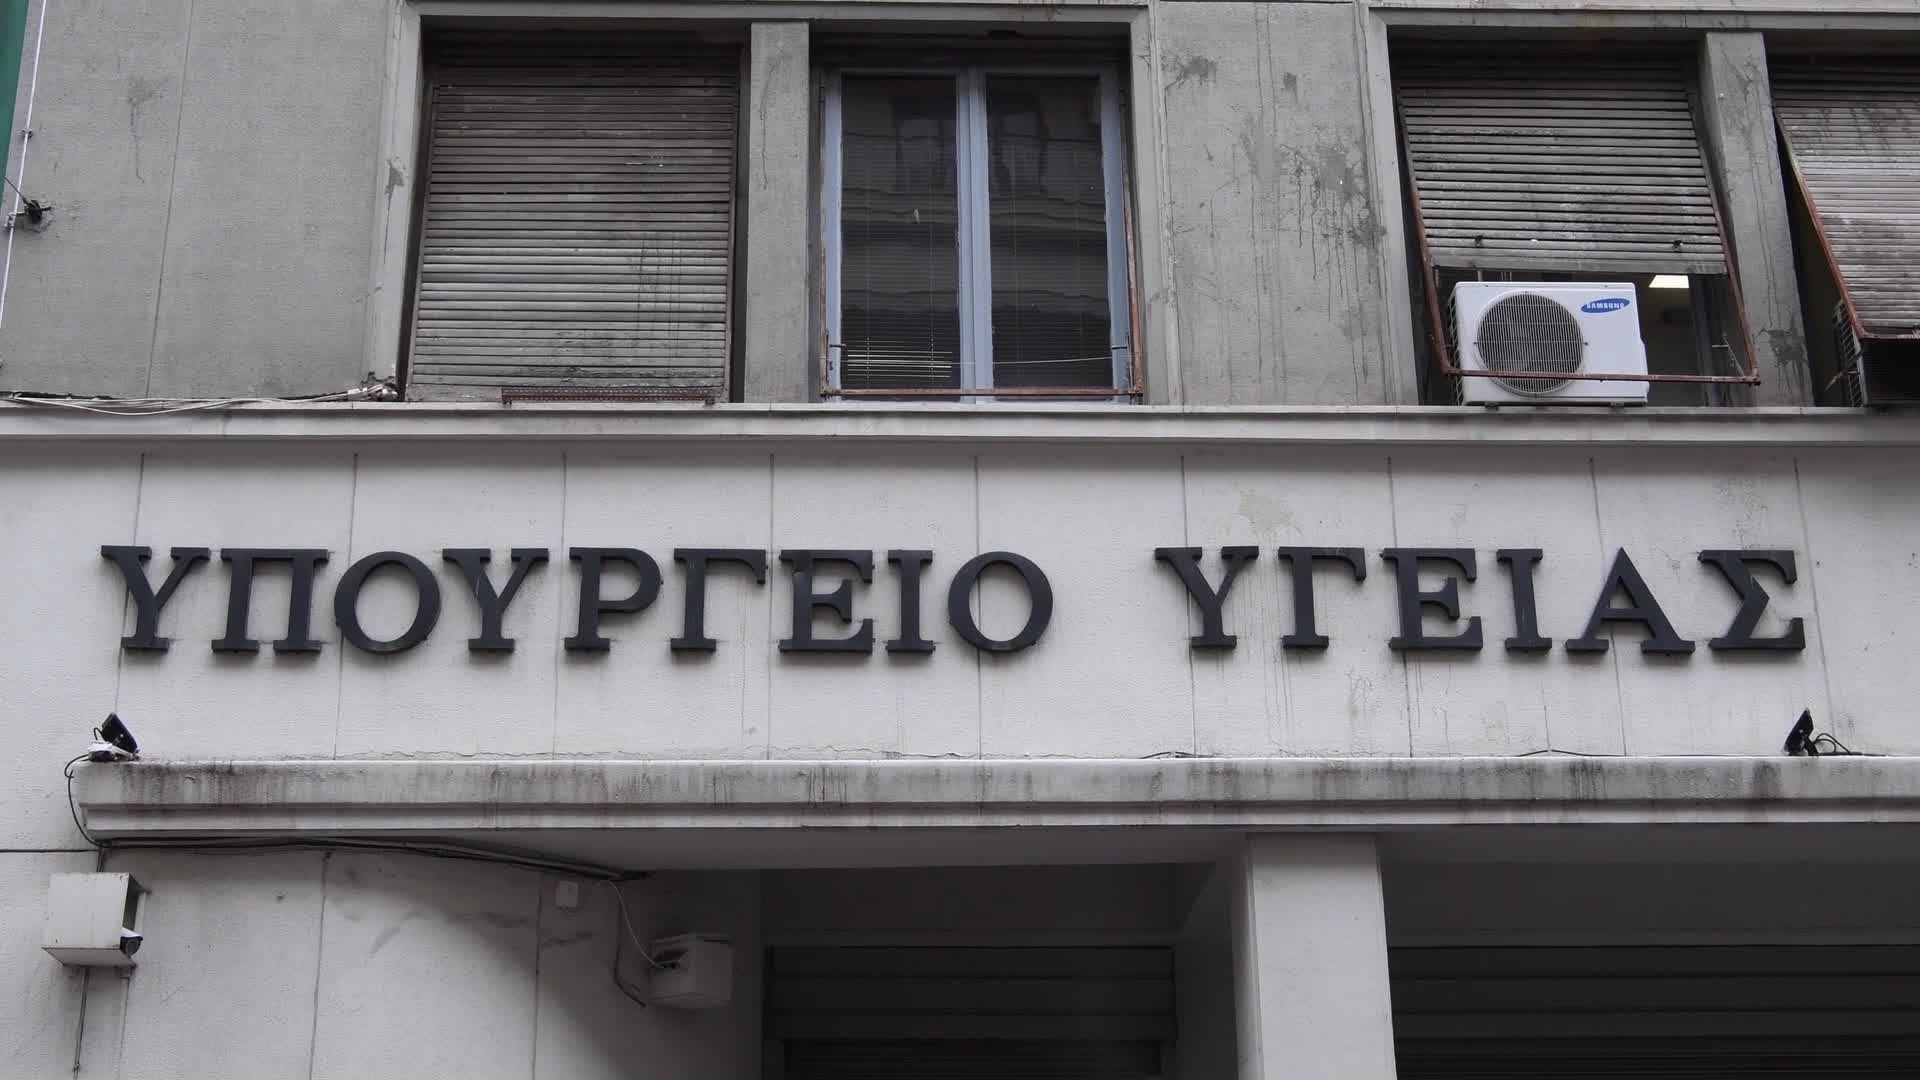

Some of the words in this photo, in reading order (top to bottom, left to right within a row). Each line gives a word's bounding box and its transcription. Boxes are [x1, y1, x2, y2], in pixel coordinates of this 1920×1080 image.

[1585, 302, 1626, 310] SAMSUNG
[101, 546, 1054, 666] ΥΠΟΥΡΓΕΙΟ
[1155, 546, 1806, 667] ΥΓΕΙΑΣ
